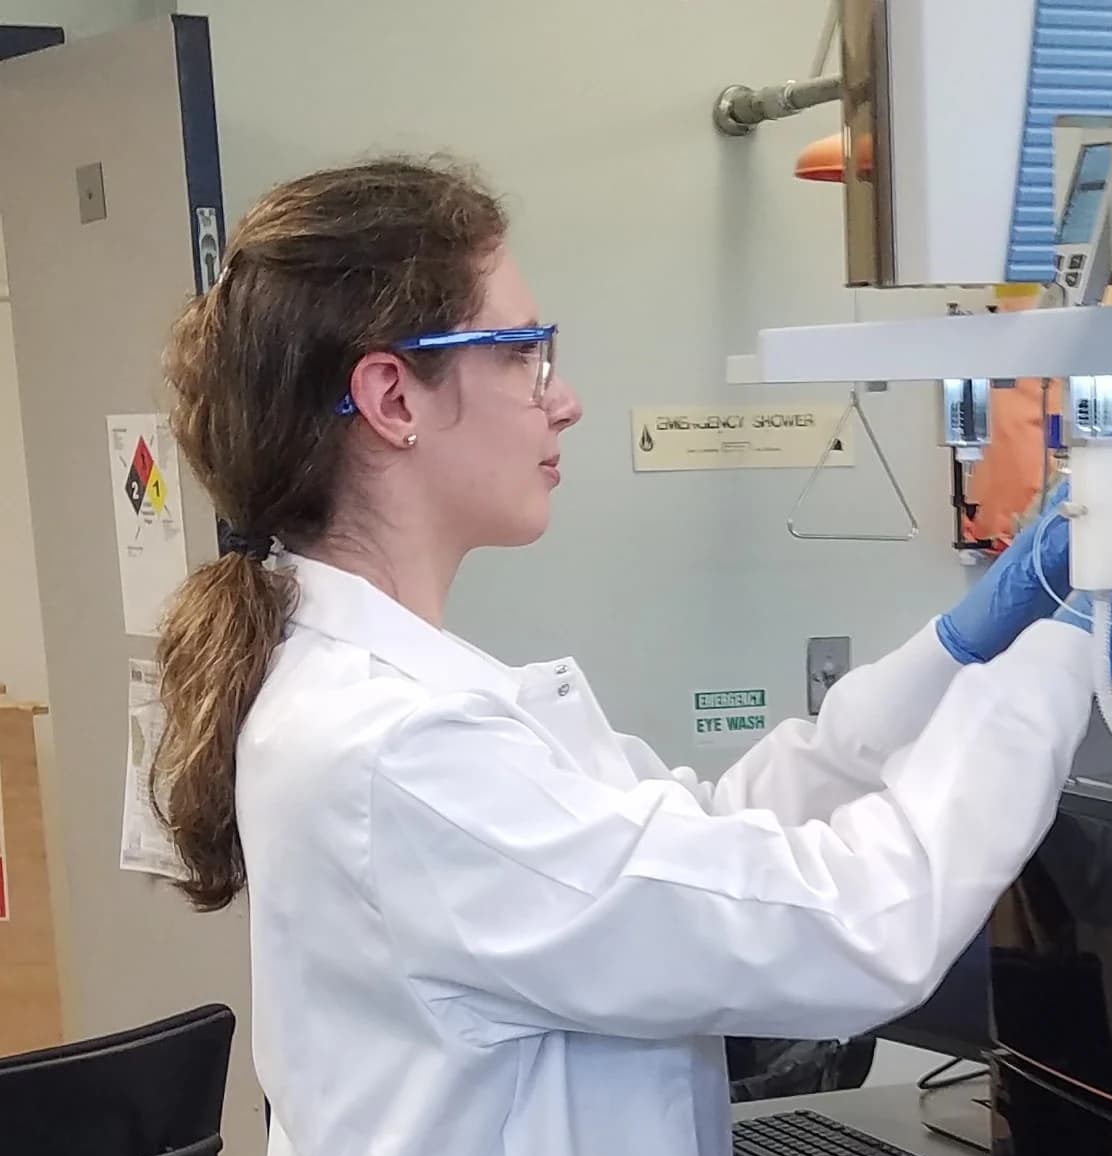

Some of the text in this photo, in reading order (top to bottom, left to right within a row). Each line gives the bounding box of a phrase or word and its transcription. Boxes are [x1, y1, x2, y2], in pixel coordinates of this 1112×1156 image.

[656, 413, 814, 431] EMERGENCY SHOWER
[131, 480, 140, 500] 2
[152, 479, 161, 498] 1
[697, 715, 765, 733] EYE WASH
